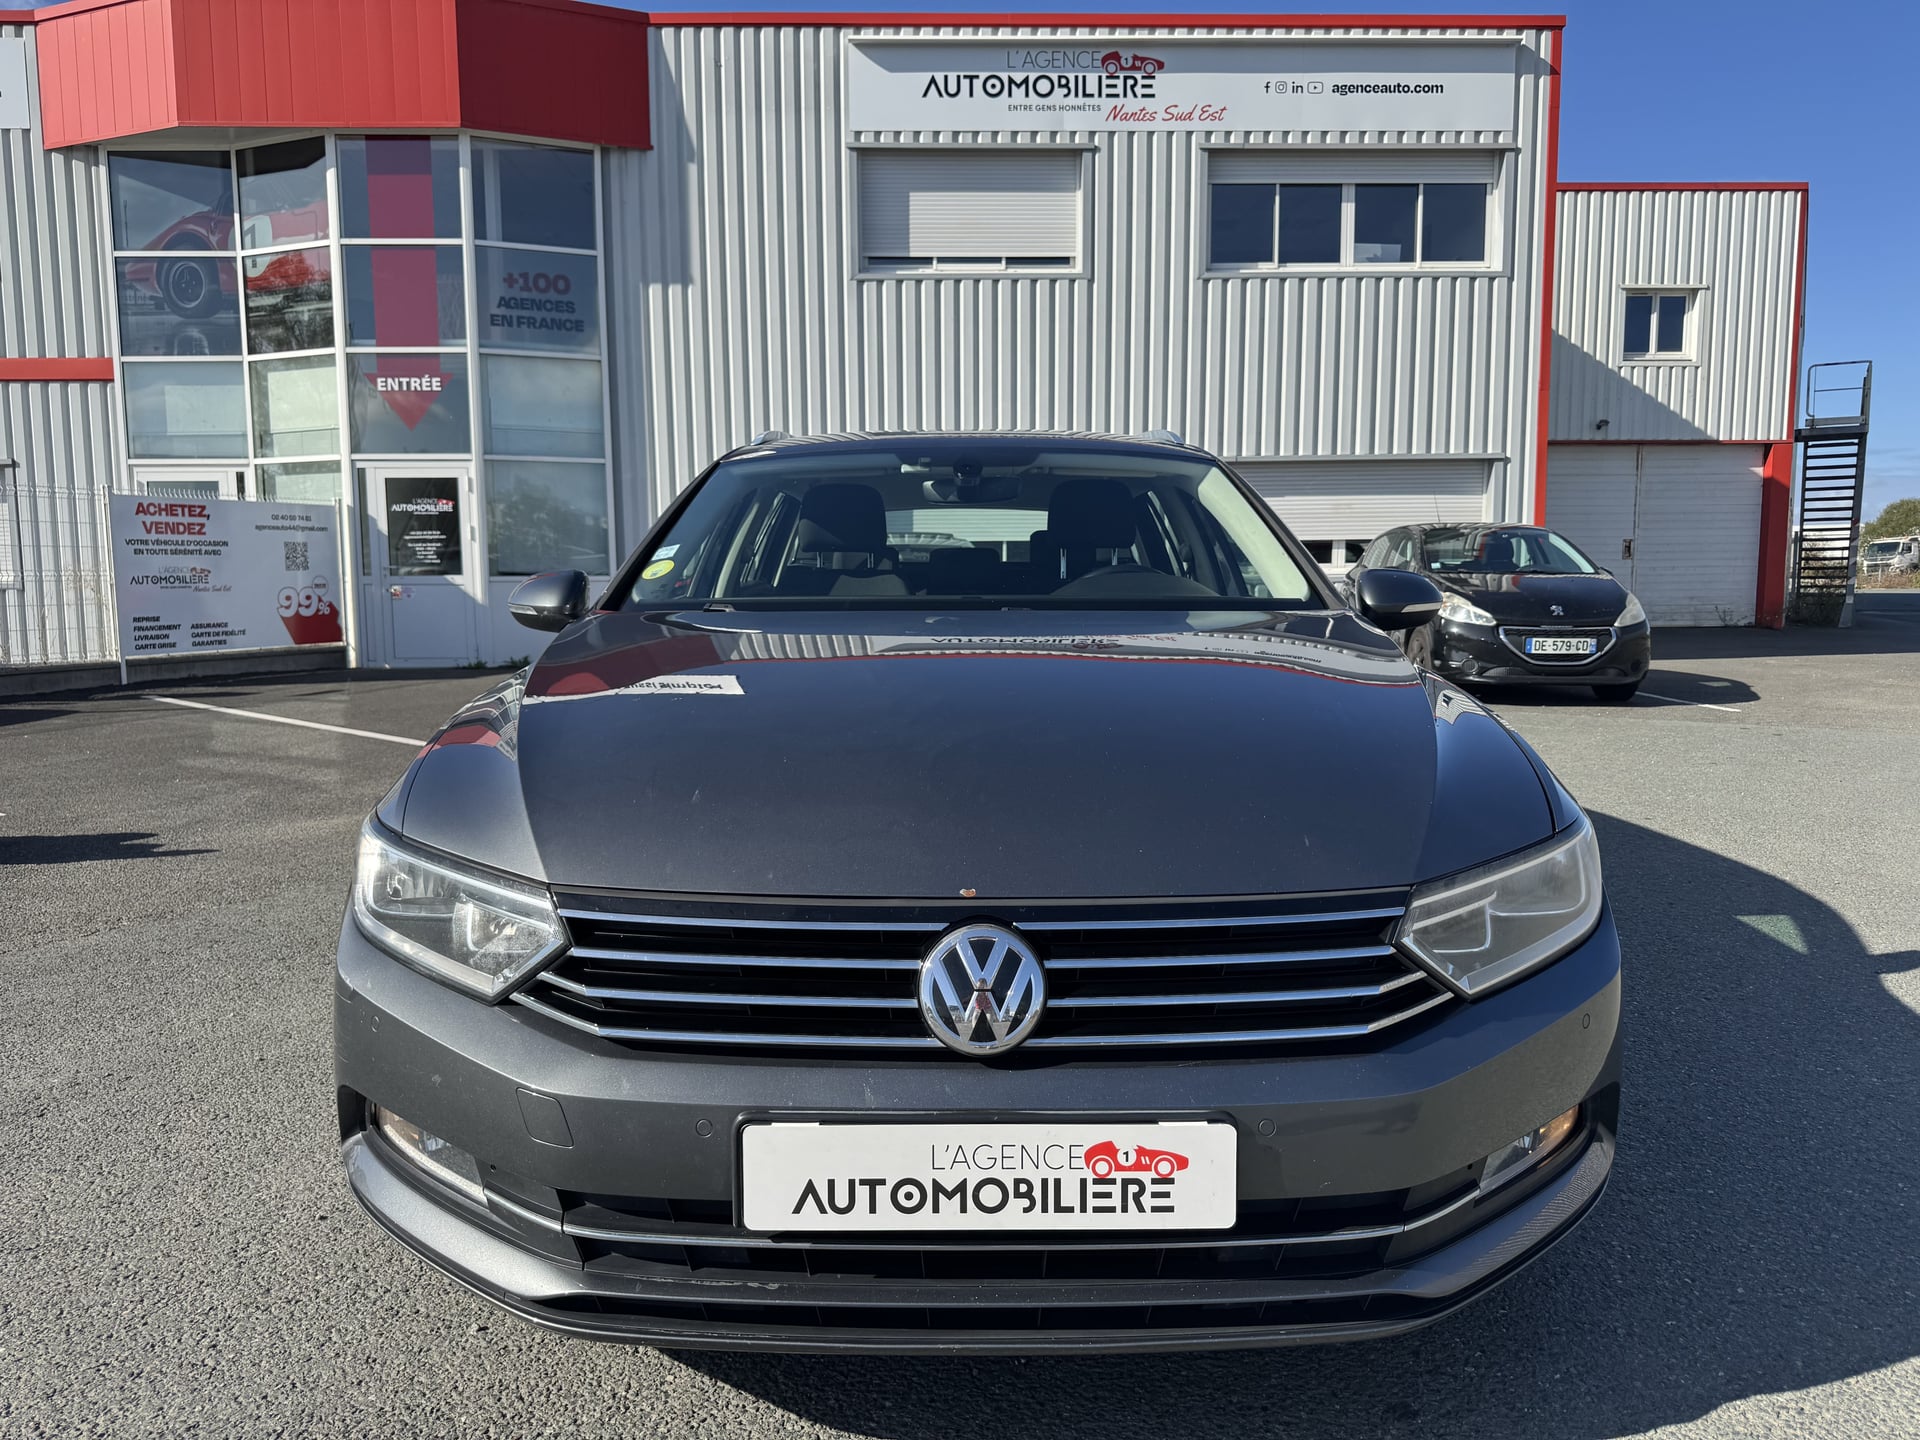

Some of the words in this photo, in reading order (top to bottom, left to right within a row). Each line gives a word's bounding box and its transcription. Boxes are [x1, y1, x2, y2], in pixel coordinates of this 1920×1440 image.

[1006, 50, 1101, 69] L'AGENCE
[1331, 82, 1444, 96] agenceauto.com
[1008, 104, 1034, 112] ENTRE
[1035, 104, 1057, 112] GENS
[1058, 102, 1102, 112] HONNÊTES
[1105, 104, 1158, 122] Nantes
[1161, 104, 1195, 122] Sud
[1198, 104, 1228, 122] Est
[503, 272, 572, 296] +100
[496, 296, 576, 314] AGENCES
[490, 314, 513, 328] EN
[516, 316, 584, 332] FRANCE
[376, 374, 442, 392] ENTRÉE
[135, 502, 210, 520] ACHETEZ,
[142, 520, 206, 536] VENDEZ
[150, 538, 186, 547] VÉHICULE
[169, 548, 202, 556] SÉRÉNITÉ
[133, 624, 181, 632] FINANCEMENT
[1534, 640, 1589, 652] DE-579-CD
[931, 1144, 1084, 1170] L'AGENCE
